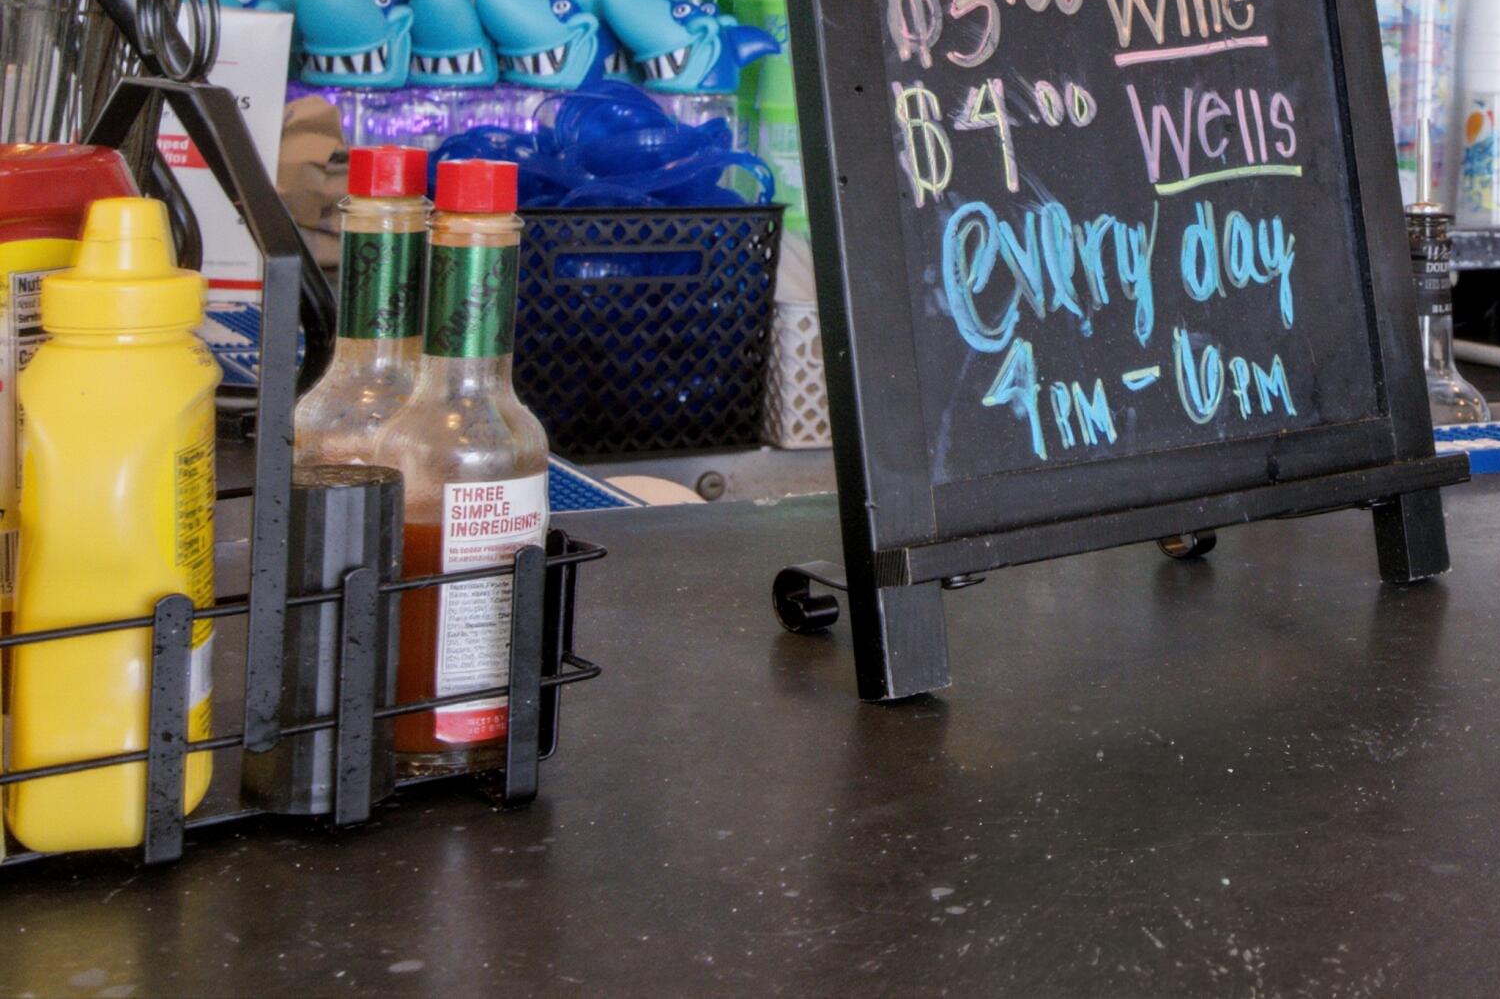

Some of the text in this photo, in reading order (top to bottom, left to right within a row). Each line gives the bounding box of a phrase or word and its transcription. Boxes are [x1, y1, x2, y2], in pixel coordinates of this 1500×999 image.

[892, 77, 1298, 208] $4.00 Wells
[942, 200, 1296, 354] every day
[451, 485, 505, 503] THREE
[451, 501, 511, 521] SIMPLE
